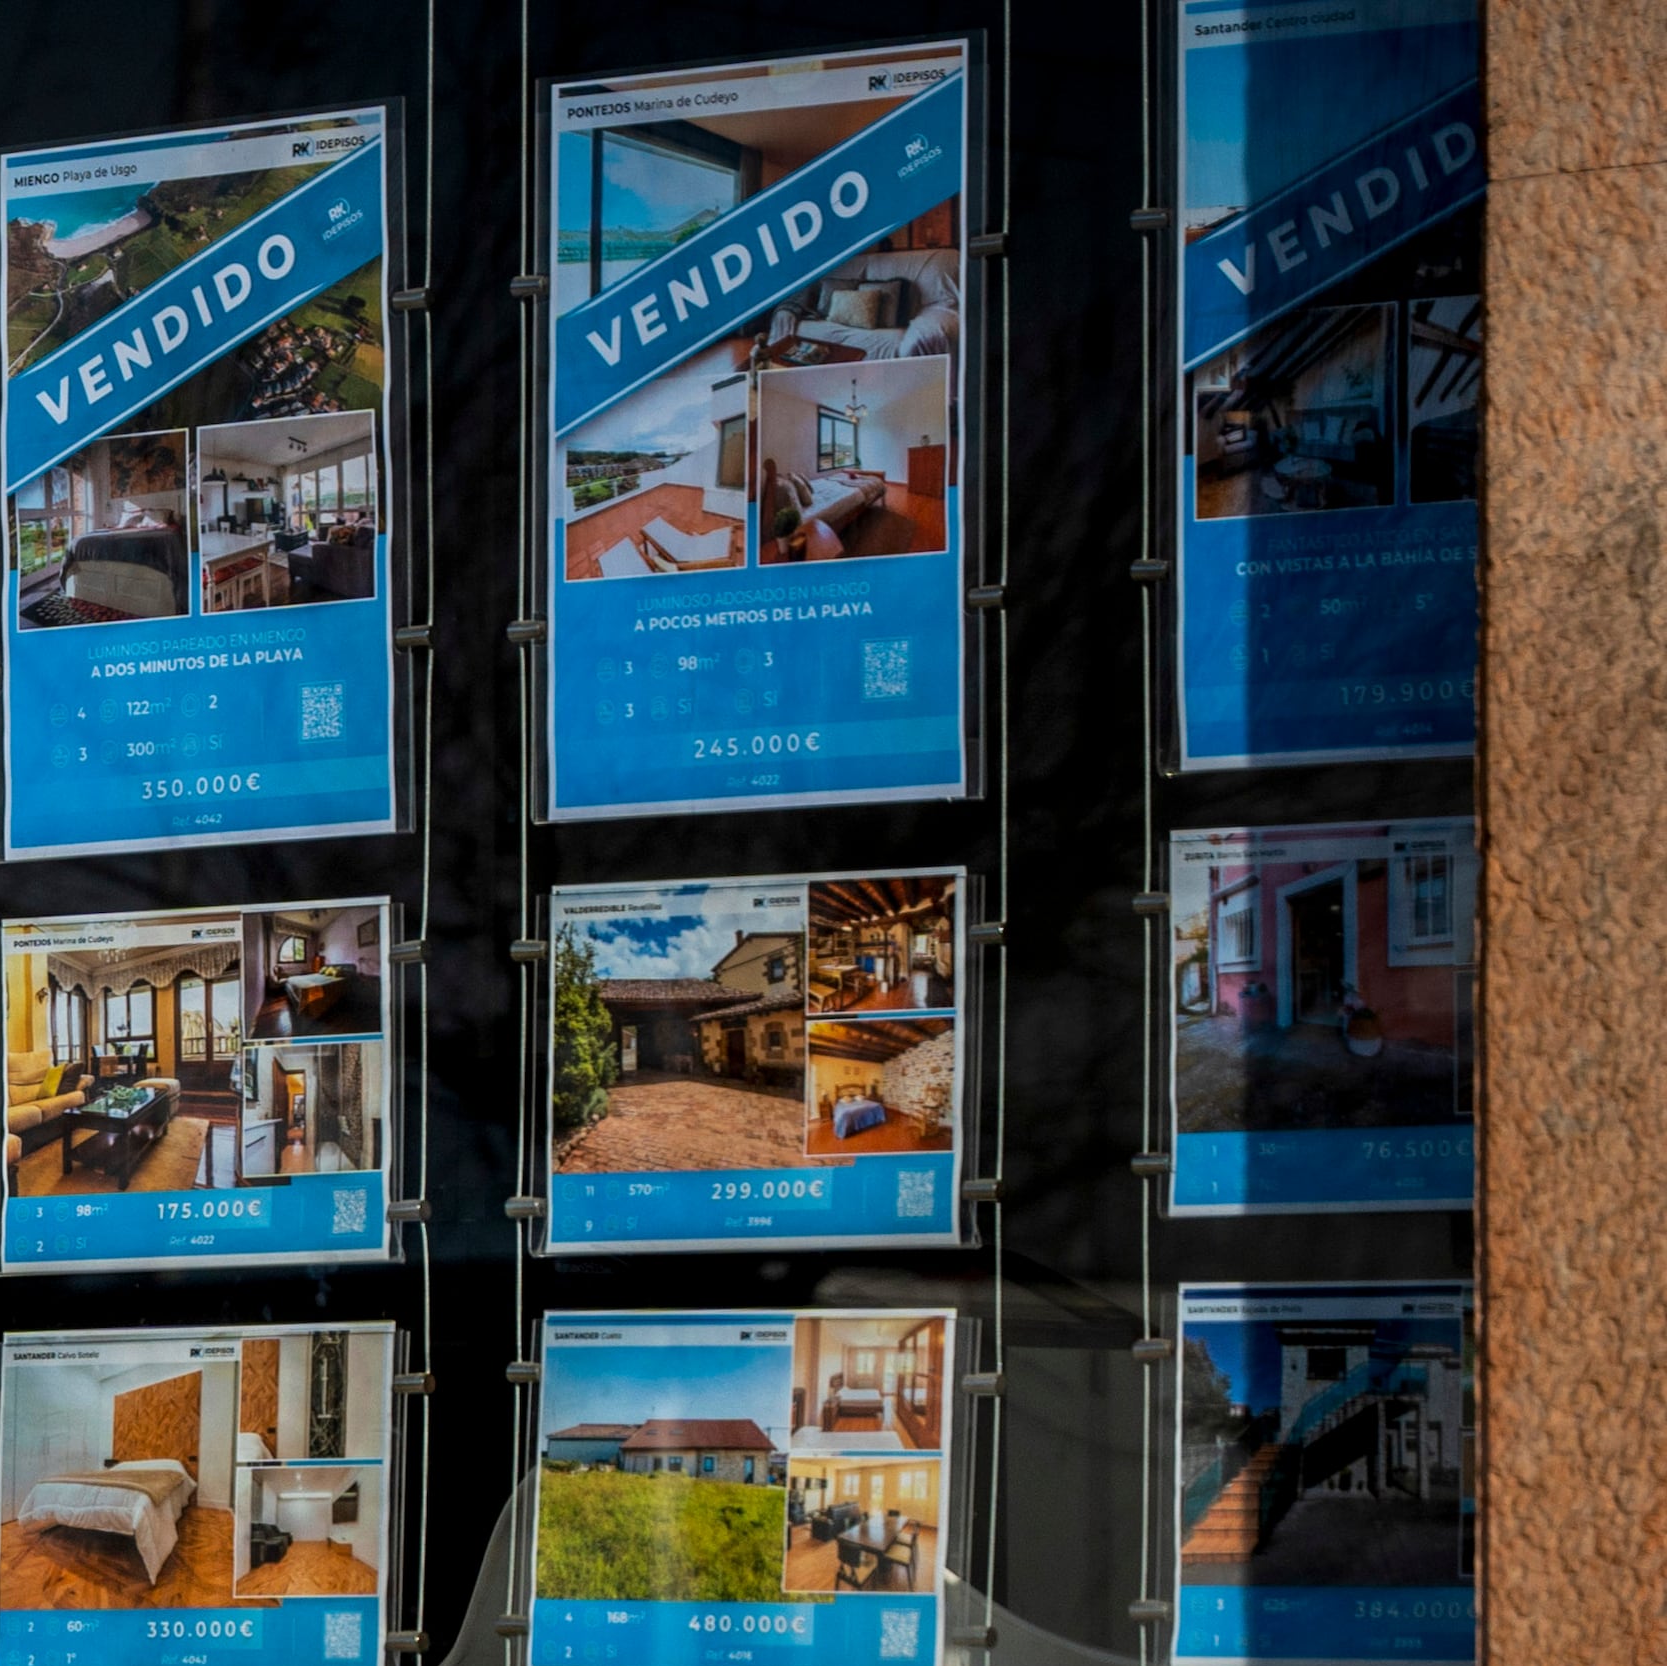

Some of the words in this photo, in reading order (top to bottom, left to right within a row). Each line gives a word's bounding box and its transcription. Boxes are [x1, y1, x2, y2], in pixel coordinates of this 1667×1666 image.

[1195, 20, 1262, 36] Santander
[1265, 17, 1308, 29] Centro
[1311, 10, 1355, 24] ciudad
[567, 102, 630, 119] PONTEJOS
[634, 97, 673, 112] Marina
[677, 95, 691, 108] de
[695, 91, 738, 108] Cudeyo
[14, 174, 59, 188] MIENGO
[63, 168, 91, 185] Playa
[95, 166, 107, 178] de
[111, 163, 137, 178] Usgo
[586, 171, 869, 367] VENDIDO
[36, 234, 295, 425] VENDIDO
[91, 666, 101, 678] A
[105, 662, 135, 676] DOS
[140, 657, 205, 673] MINUTOS
[209, 654, 228, 668] DE
[233, 653, 251, 666] LA
[255, 648, 303, 663] PLAYA
[695, 733, 820, 759] 245.000€
[142, 773, 260, 799] 350.000€
[14, 938, 51, 948] PONTEJOS
[711, 1180, 824, 1199] 299.000€
[158, 1200, 261, 1219] 175.000€
[555, 1332, 599, 1340] SANTANDER
[14, 1352, 56, 1360] SANTANDER
[147, 1620, 253, 1638] 330.000€
[688, 1615, 805, 1633] 480.000€
